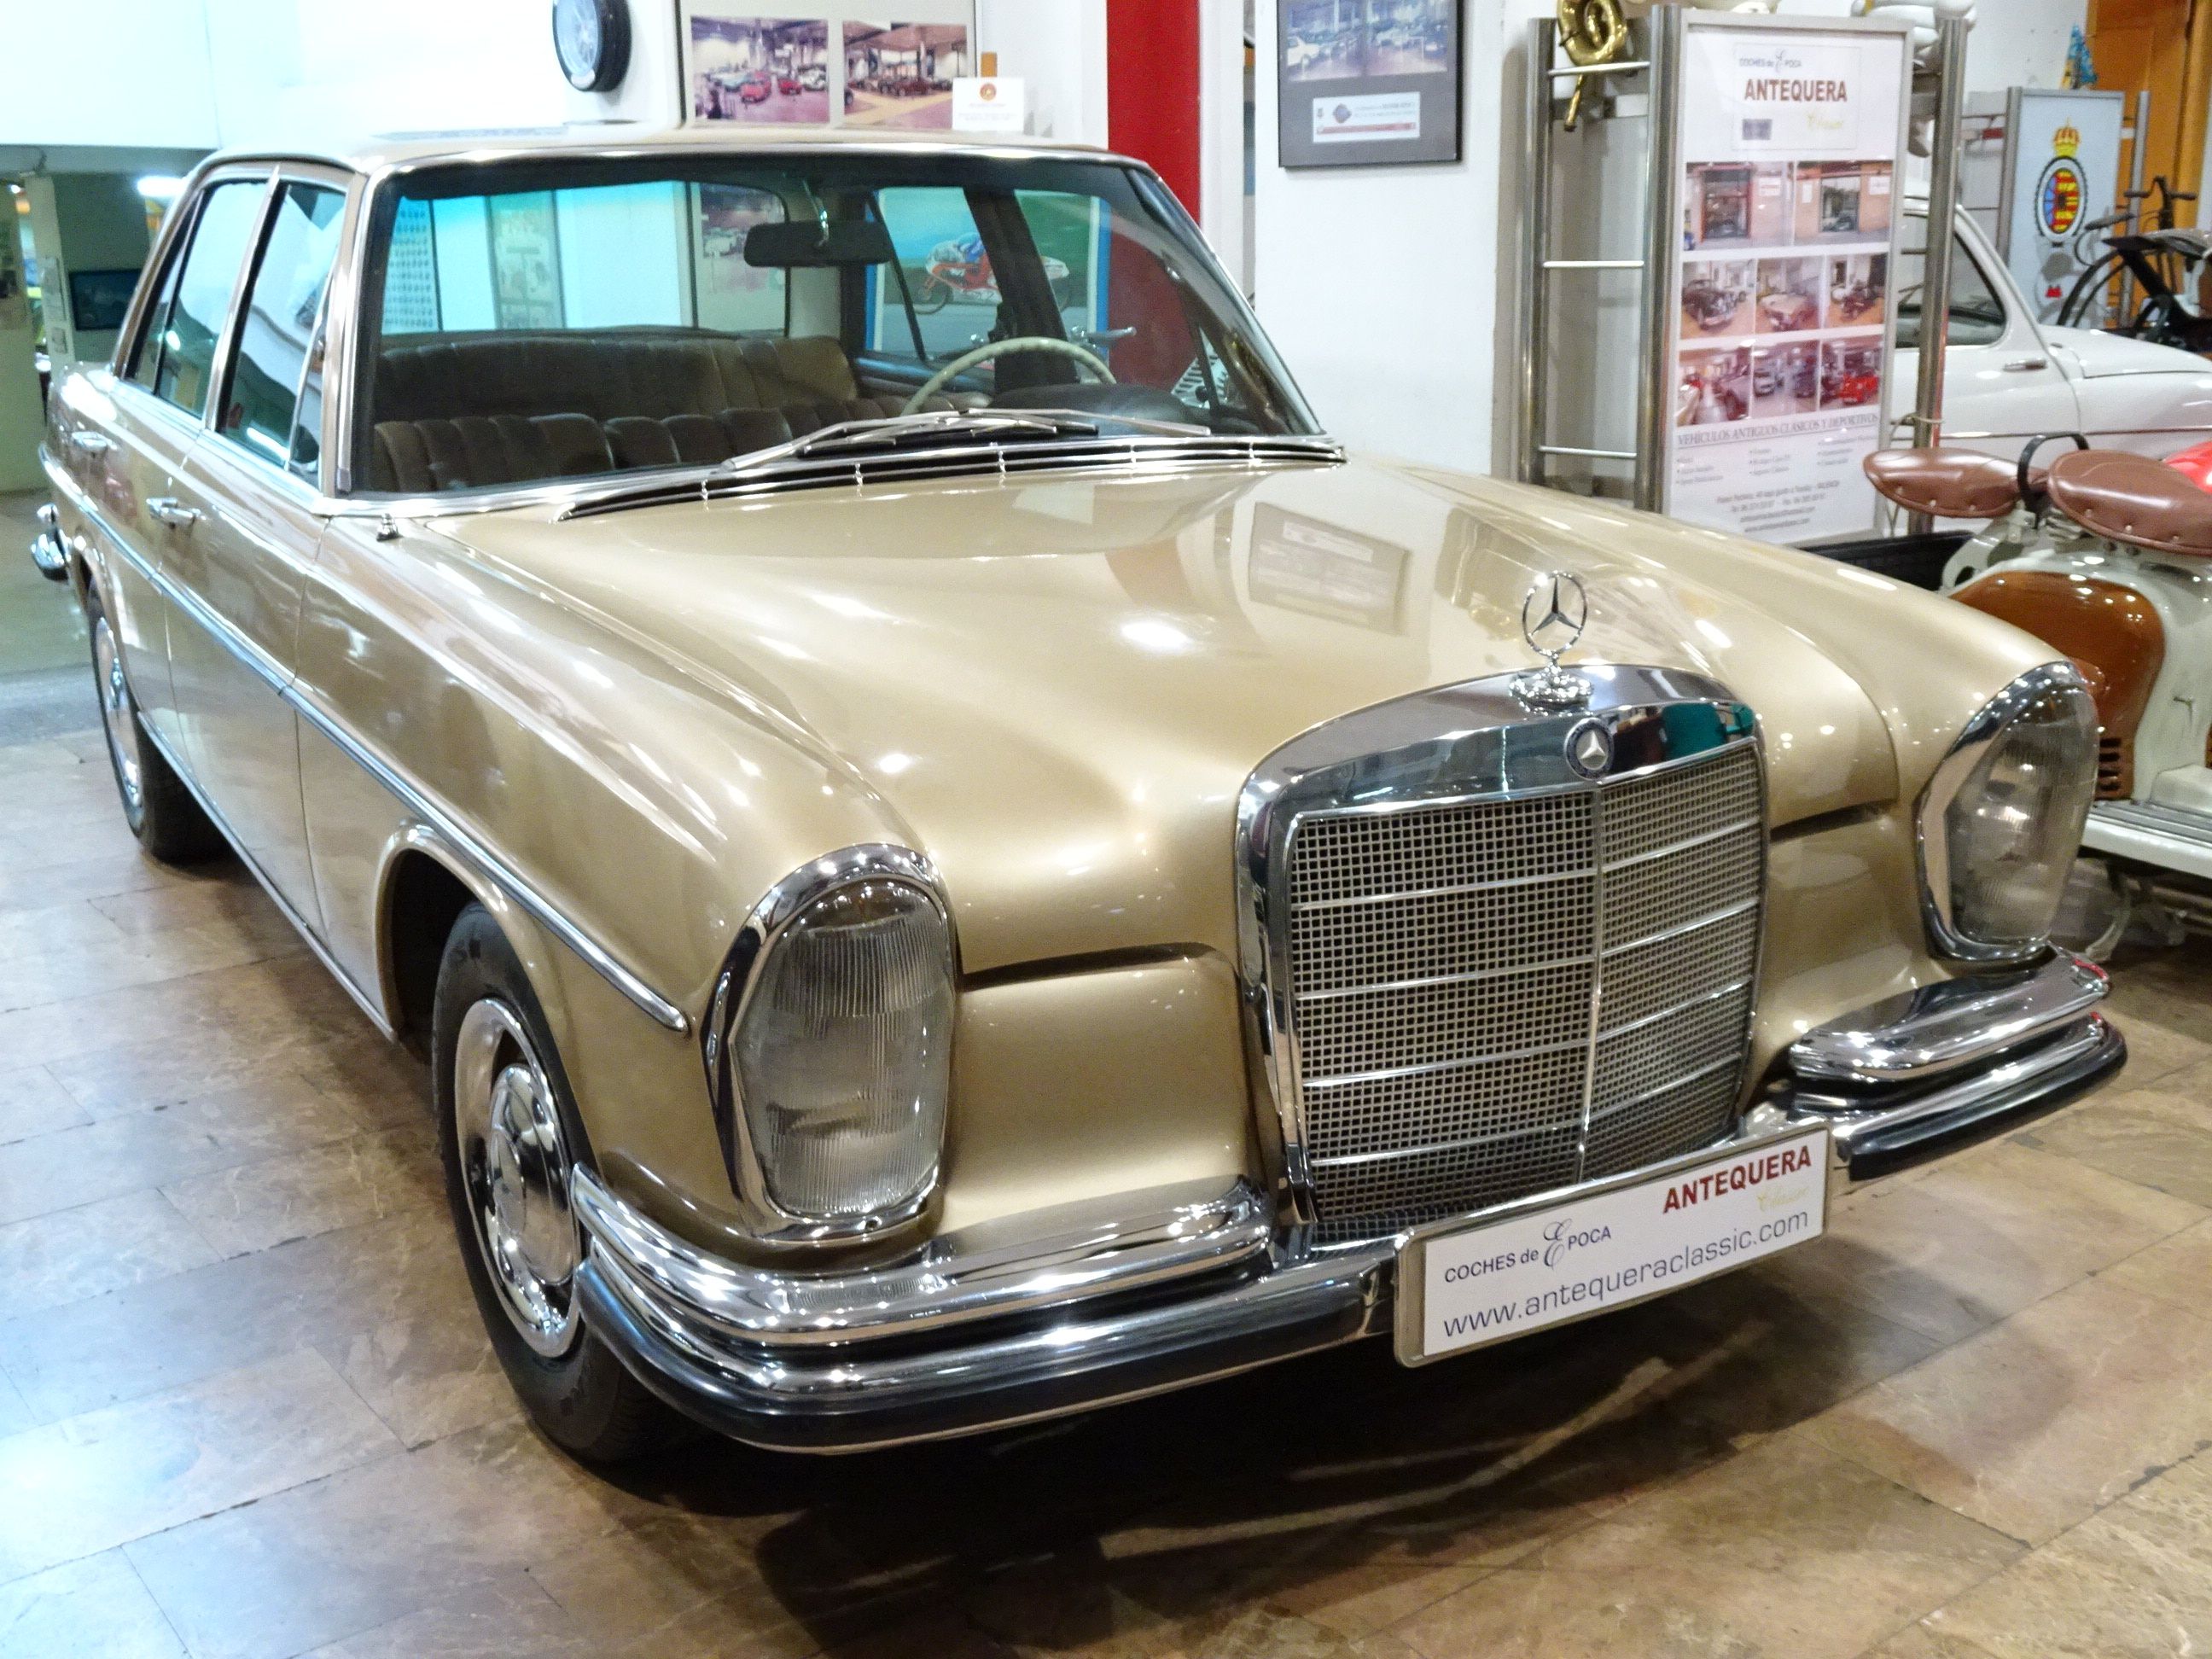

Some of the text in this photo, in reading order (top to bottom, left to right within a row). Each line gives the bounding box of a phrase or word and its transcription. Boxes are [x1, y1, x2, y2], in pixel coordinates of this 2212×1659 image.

[1744, 79, 1848, 102] ANTEQUERA
[1663, 1145, 1811, 1214] ANTEQUERA
[1443, 1210, 1808, 1338] www.antequeraclassic.com
[1444, 1252, 1516, 1284] COCHES
[1520, 1249, 1539, 1265] de
